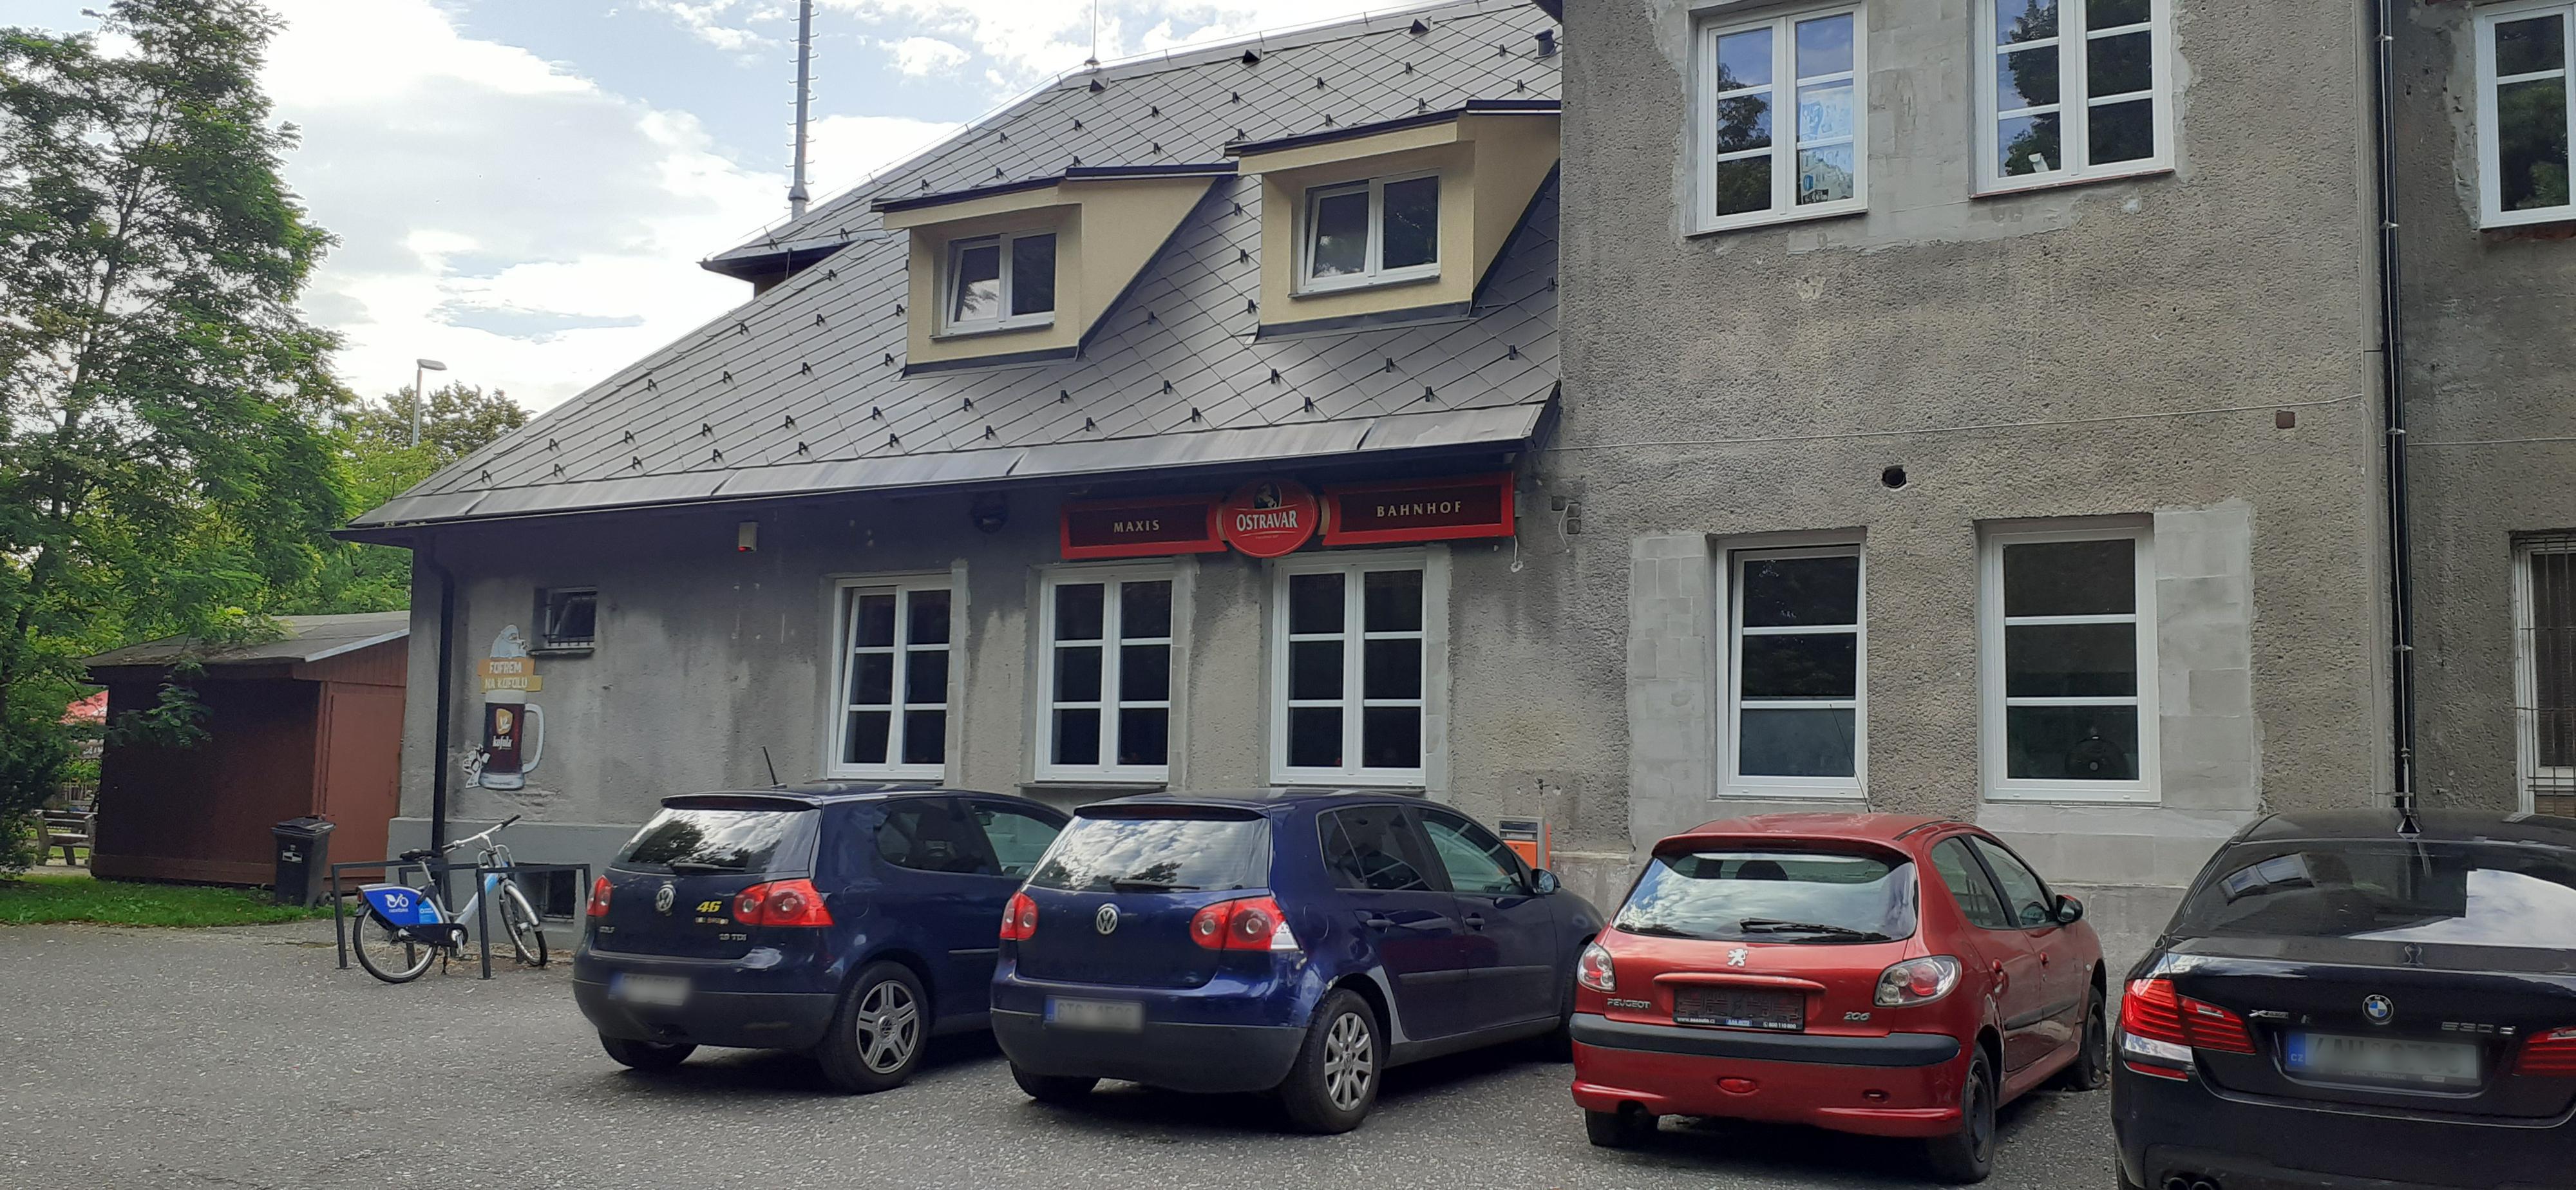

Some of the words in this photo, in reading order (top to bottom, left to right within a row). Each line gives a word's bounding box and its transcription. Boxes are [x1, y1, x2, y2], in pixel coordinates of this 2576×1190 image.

[1377, 501, 1461, 517] BAHNHOF
[1236, 510, 1298, 531] OSTRAVAR
[1113, 520, 1160, 533] MAXIS
[485, 677, 495, 689] NA
[498, 677, 527, 688] KOFOLU
[696, 901, 722, 912] 46
[1607, 998, 1651, 1008] PEUGEOT
[1844, 1012, 1870, 1021] 206
[2441, 1022, 2494, 1033] 530
[2290, 1053, 2304, 1062] CZ
